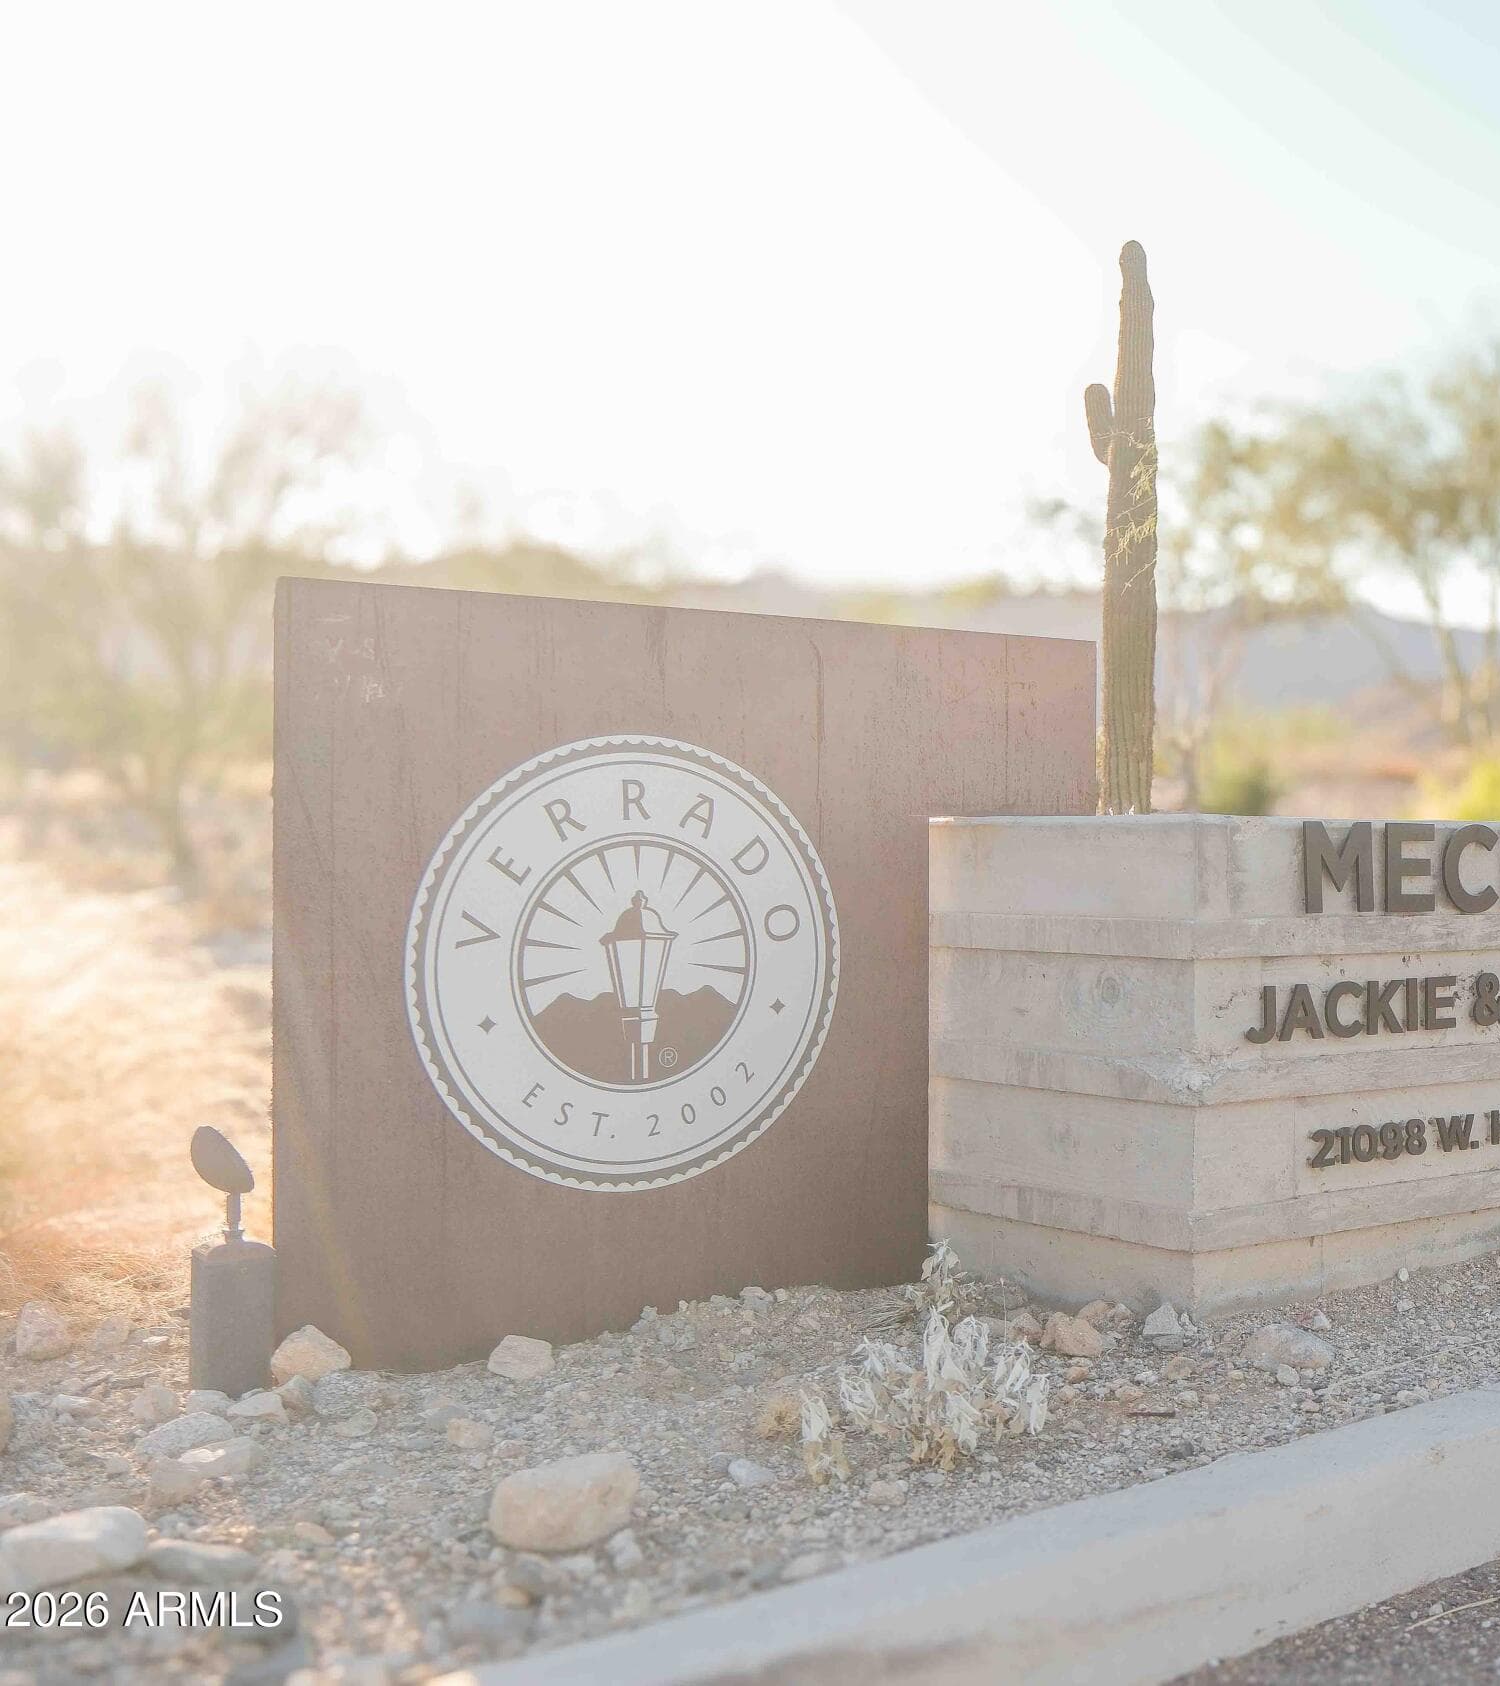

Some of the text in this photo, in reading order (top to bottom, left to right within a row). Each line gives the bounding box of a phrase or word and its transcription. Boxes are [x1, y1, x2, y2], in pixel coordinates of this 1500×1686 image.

[455, 778, 801, 950] VERRADO
[1245, 975, 1457, 1044] JACKIE
[522, 1061, 755, 1139] EST. 2002
[1309, 1118, 1428, 1168] 21098
[1433, 1113, 1479, 1152] W.
